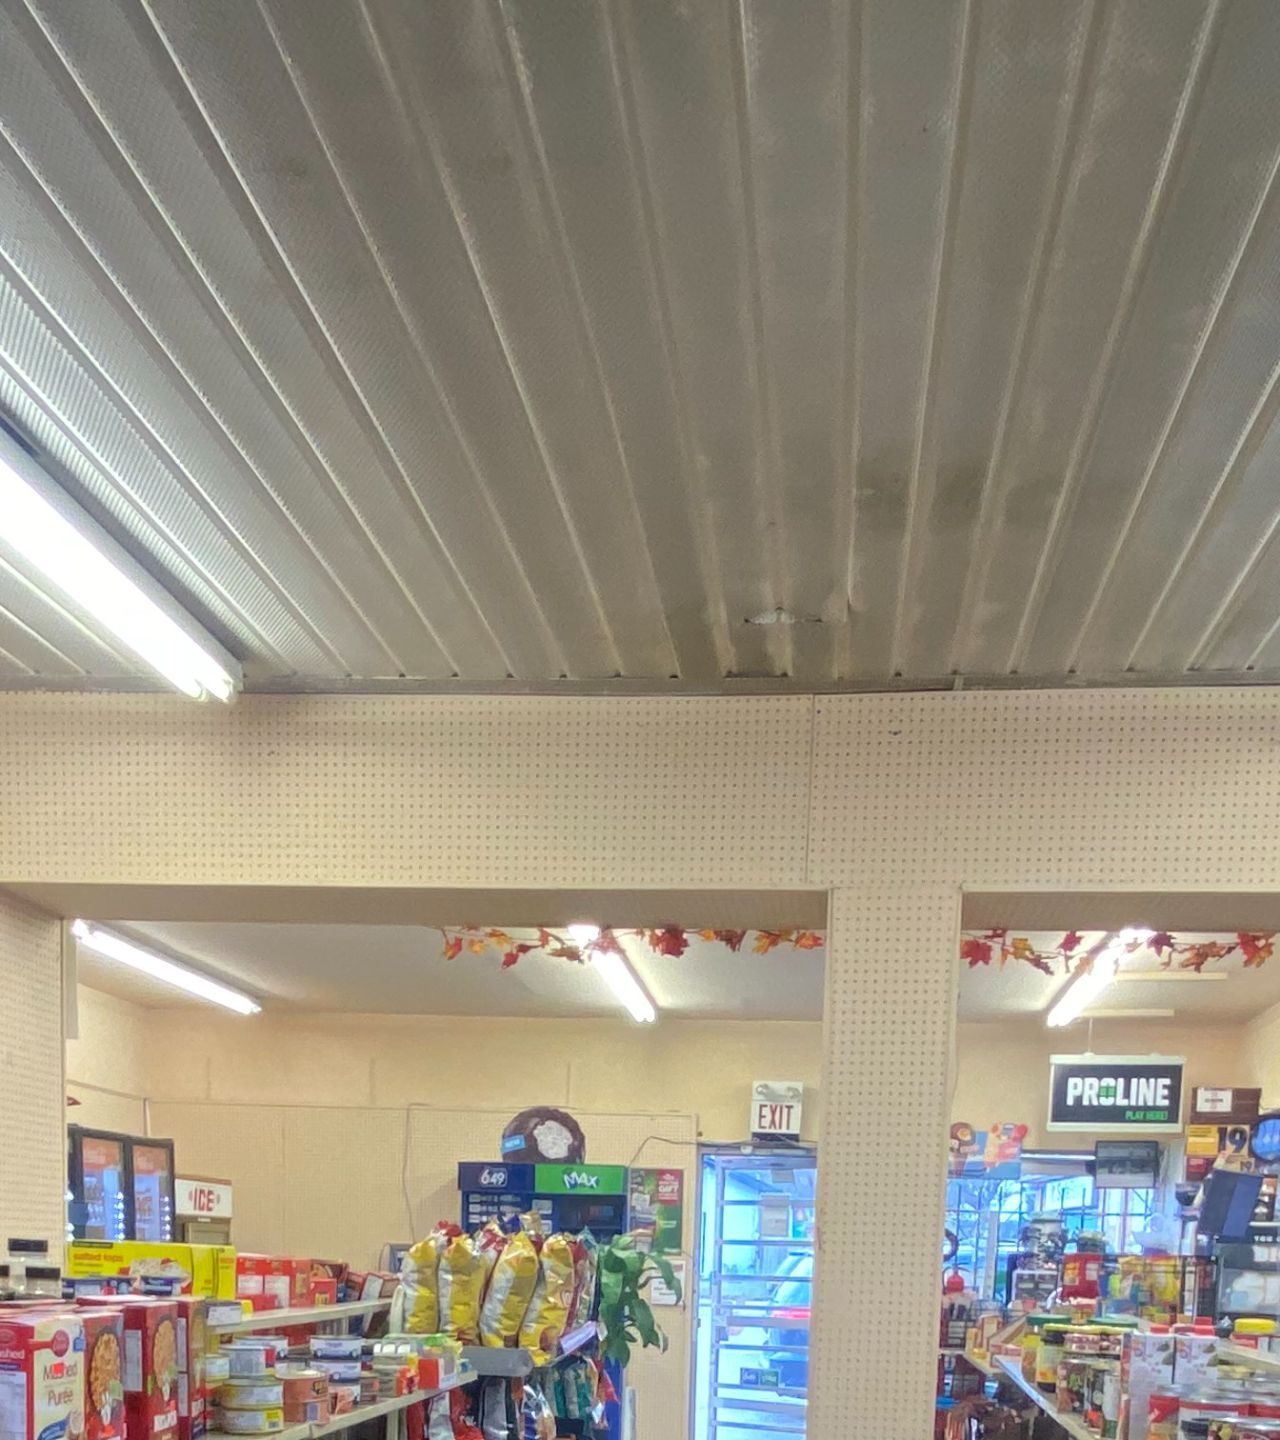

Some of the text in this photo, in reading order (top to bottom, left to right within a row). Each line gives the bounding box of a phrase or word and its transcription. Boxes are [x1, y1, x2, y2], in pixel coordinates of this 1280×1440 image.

[1066, 1077, 1171, 1106] PROLINE
[758, 1104, 794, 1130] EXIT
[1125, 1111, 1144, 1121] PLAY
[563, 1172, 598, 1188] MAX
[193, 1188, 215, 1212] ICE
